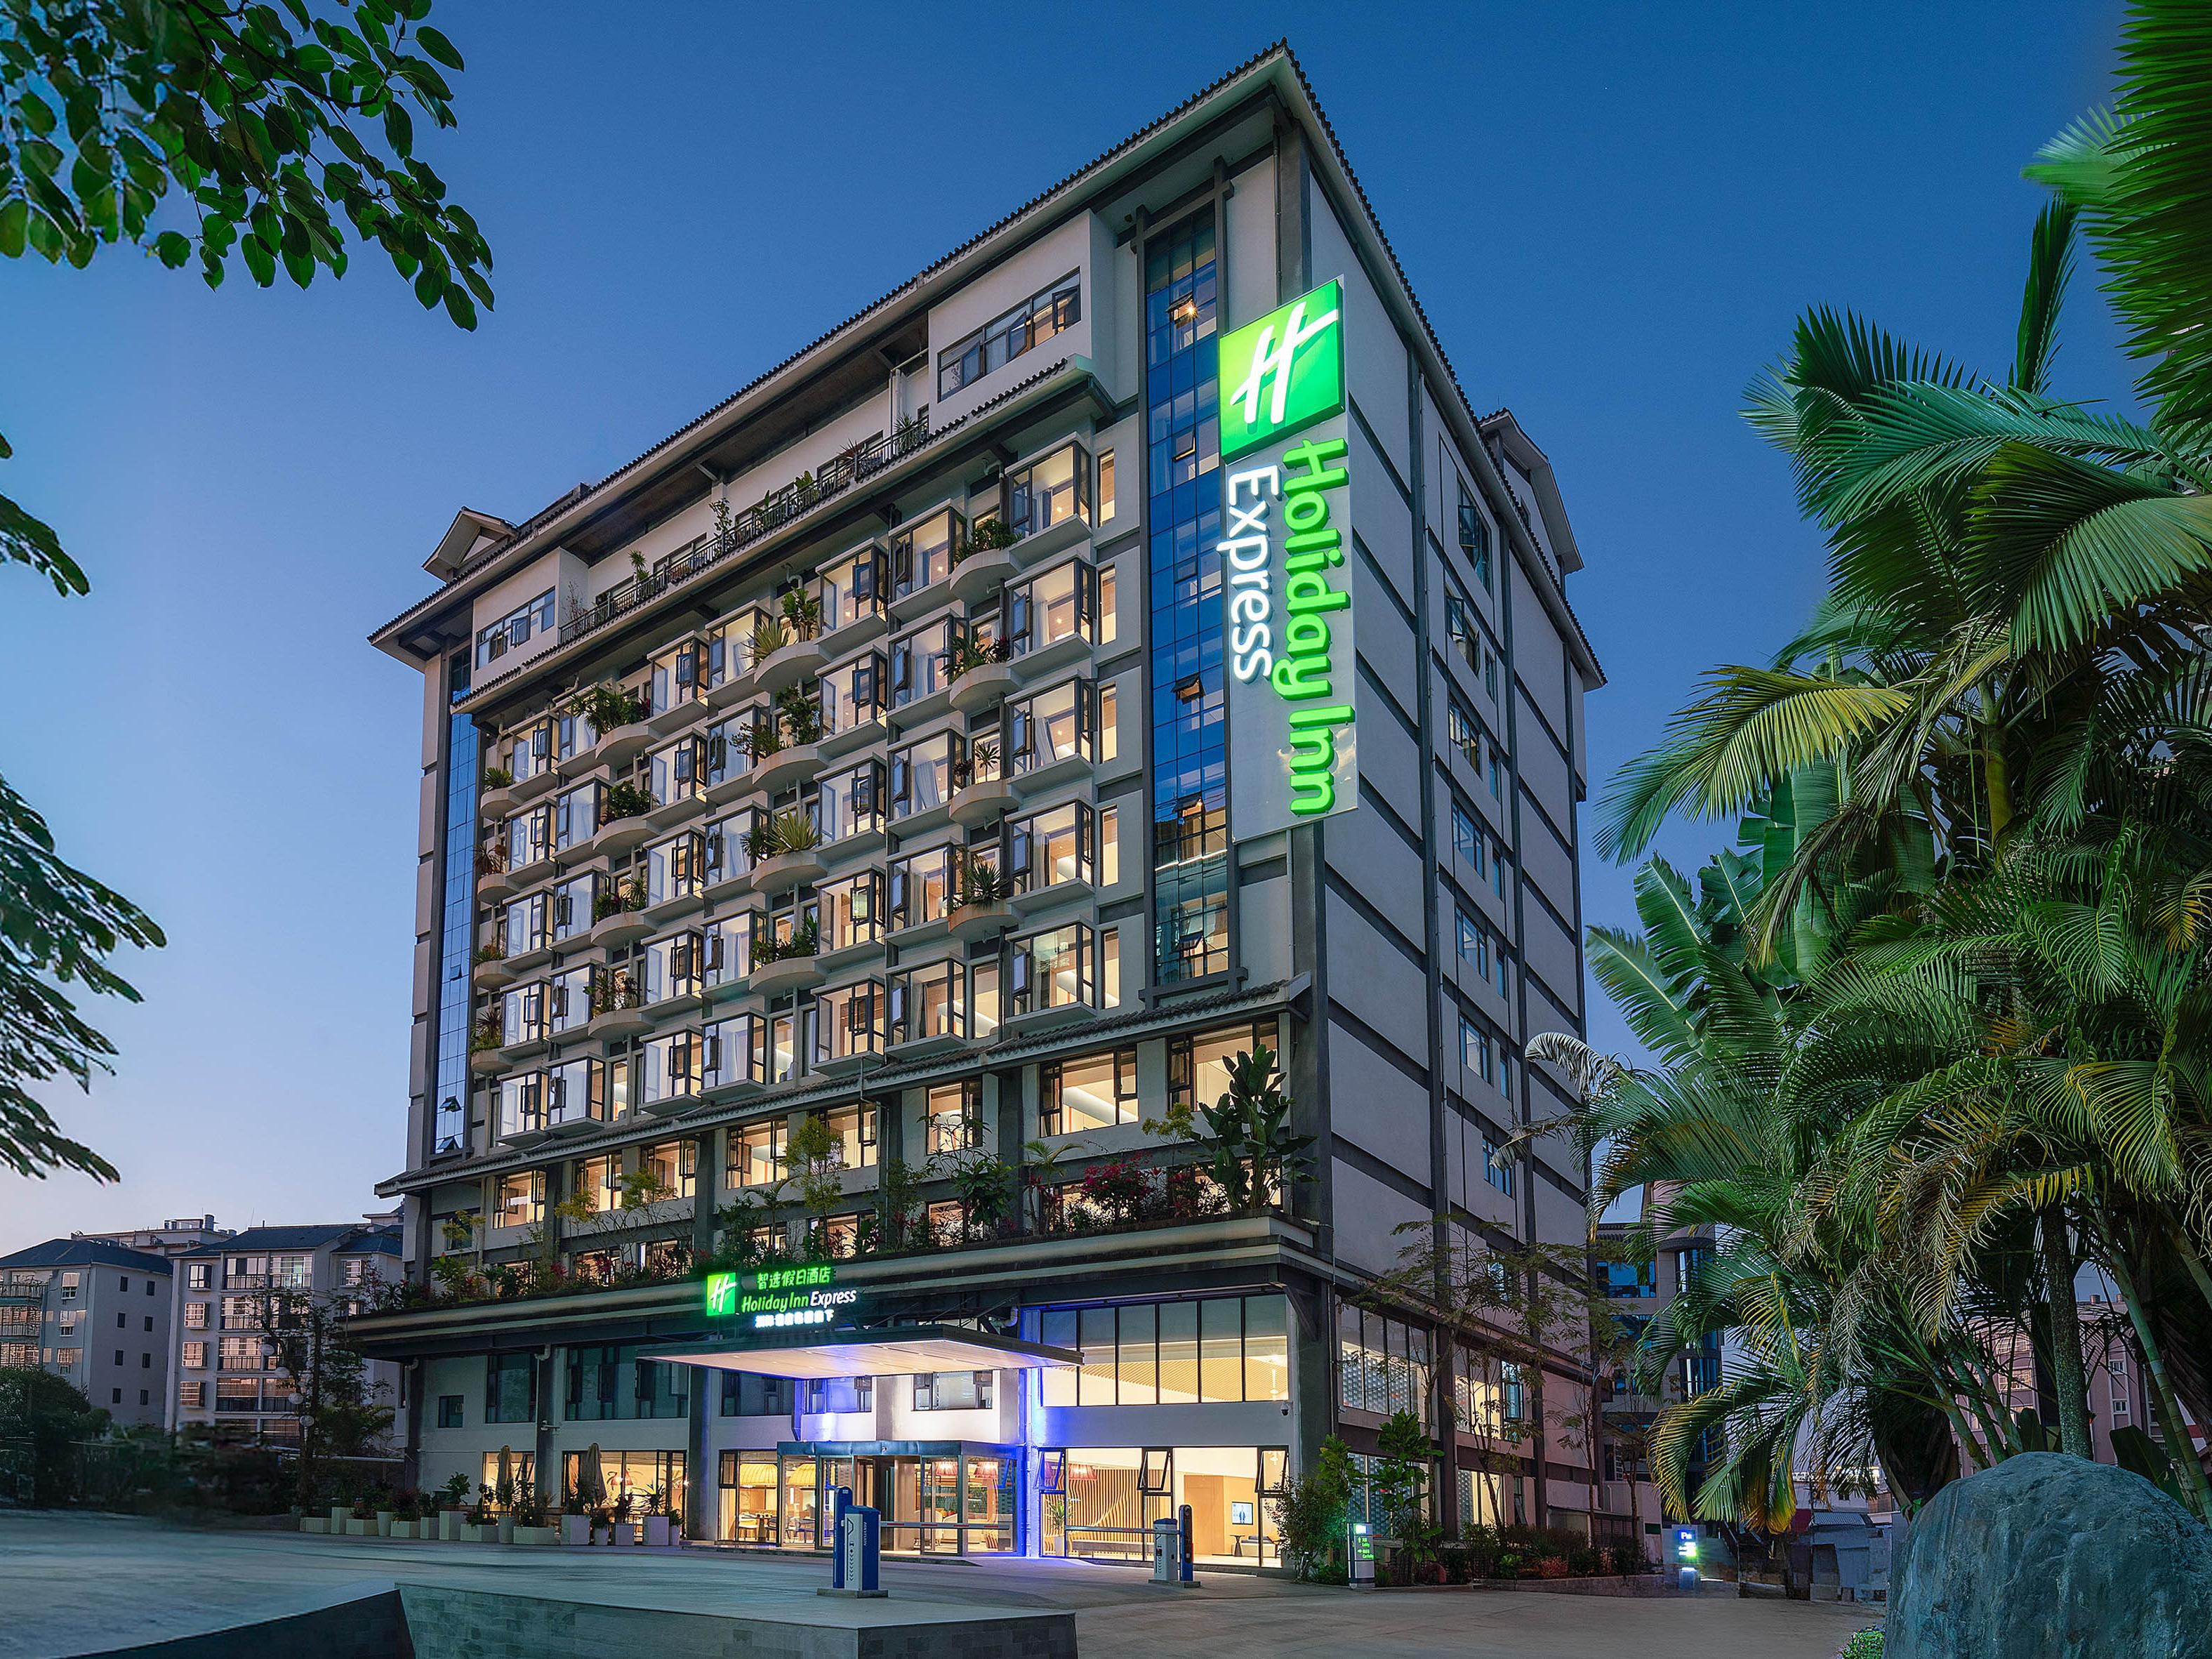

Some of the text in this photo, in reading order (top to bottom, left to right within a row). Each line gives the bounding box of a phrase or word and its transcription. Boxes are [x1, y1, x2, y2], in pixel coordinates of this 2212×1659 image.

[1217, 463, 1280, 683] Express
[1271, 437, 1355, 817] Holiday Inn
[741, 1290, 857, 1313] Holiday Inn Express
[757, 1267, 831, 1290] 智选假日酒店
